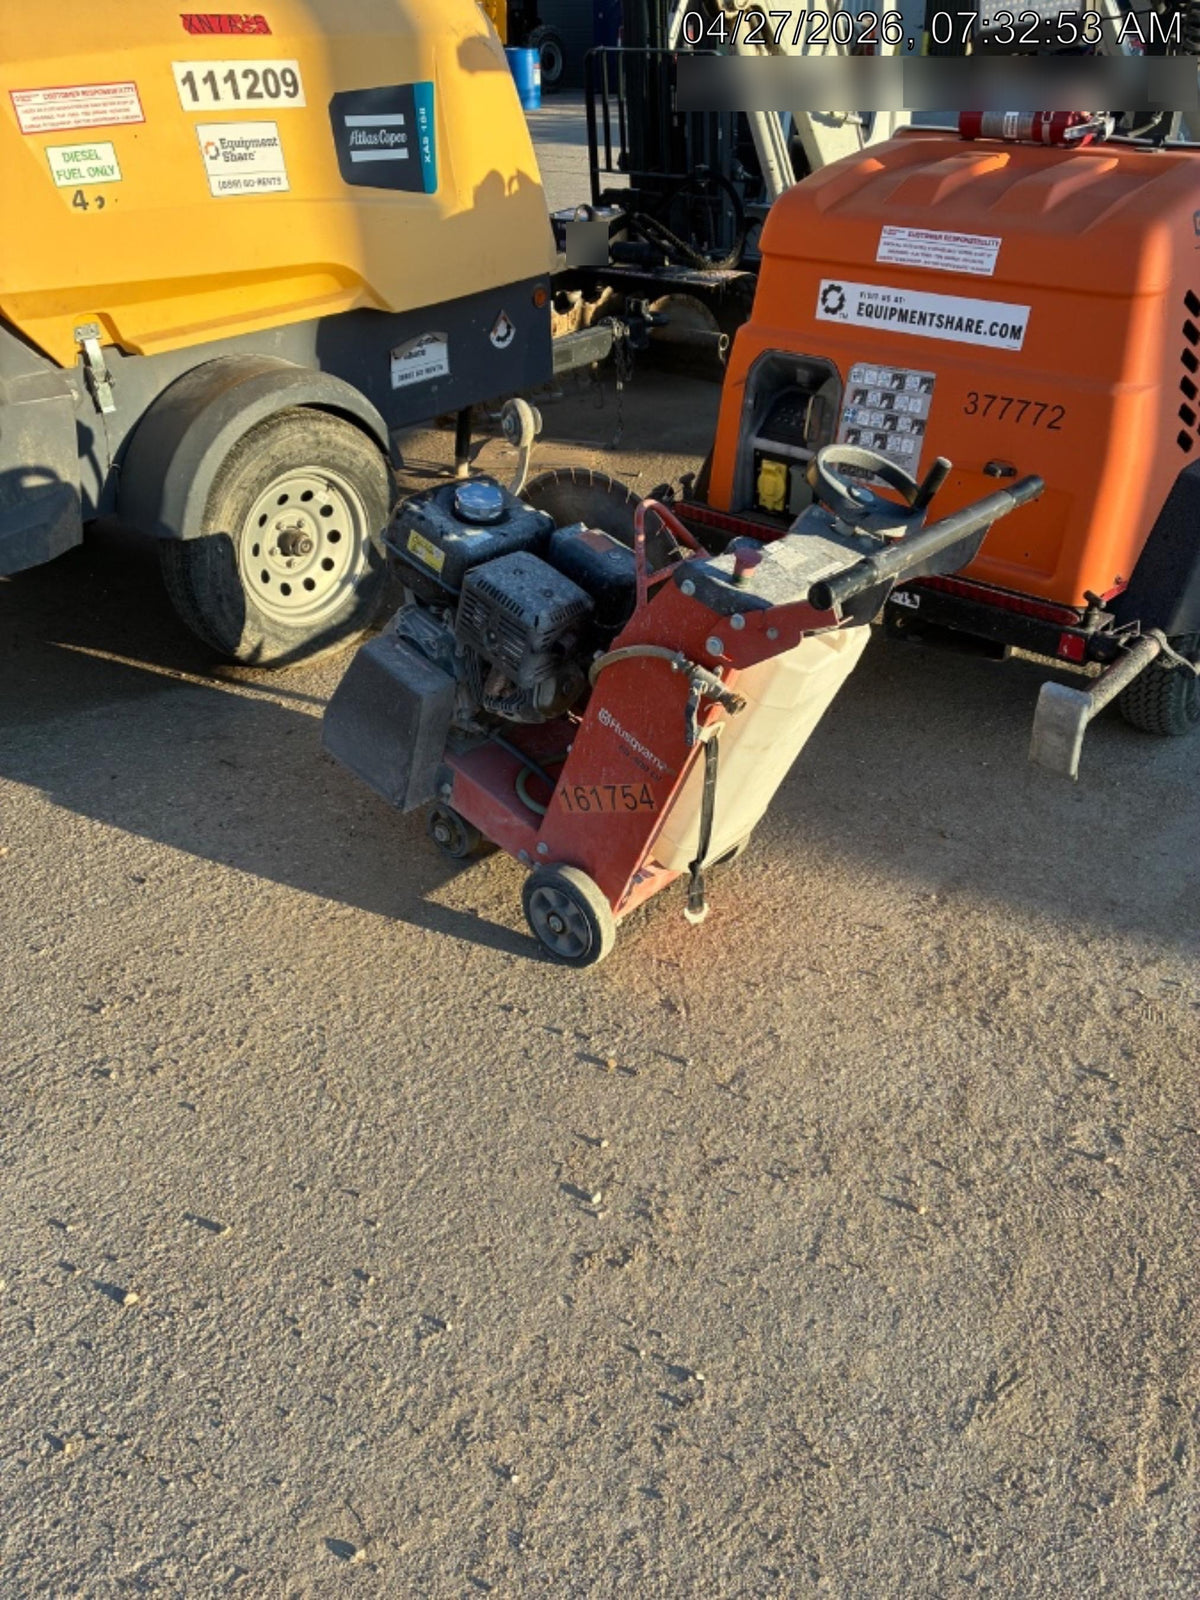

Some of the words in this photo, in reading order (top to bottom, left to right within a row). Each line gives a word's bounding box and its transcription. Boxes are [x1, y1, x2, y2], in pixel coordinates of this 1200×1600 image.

[181, 67, 299, 102] 111209
[219, 137, 278, 151] Equipment
[61, 149, 101, 163] DIESEL
[222, 150, 255, 163] Share
[56, 168, 85, 181] FUEL
[87, 164, 114, 178] ONLY
[860, 291, 879, 300] VISIT
[881, 295, 891, 303] US
[857, 302, 1023, 340] EQUIPMENTSHARE.COM
[964, 391, 1066, 430] 377772
[560, 783, 654, 812] 161754
